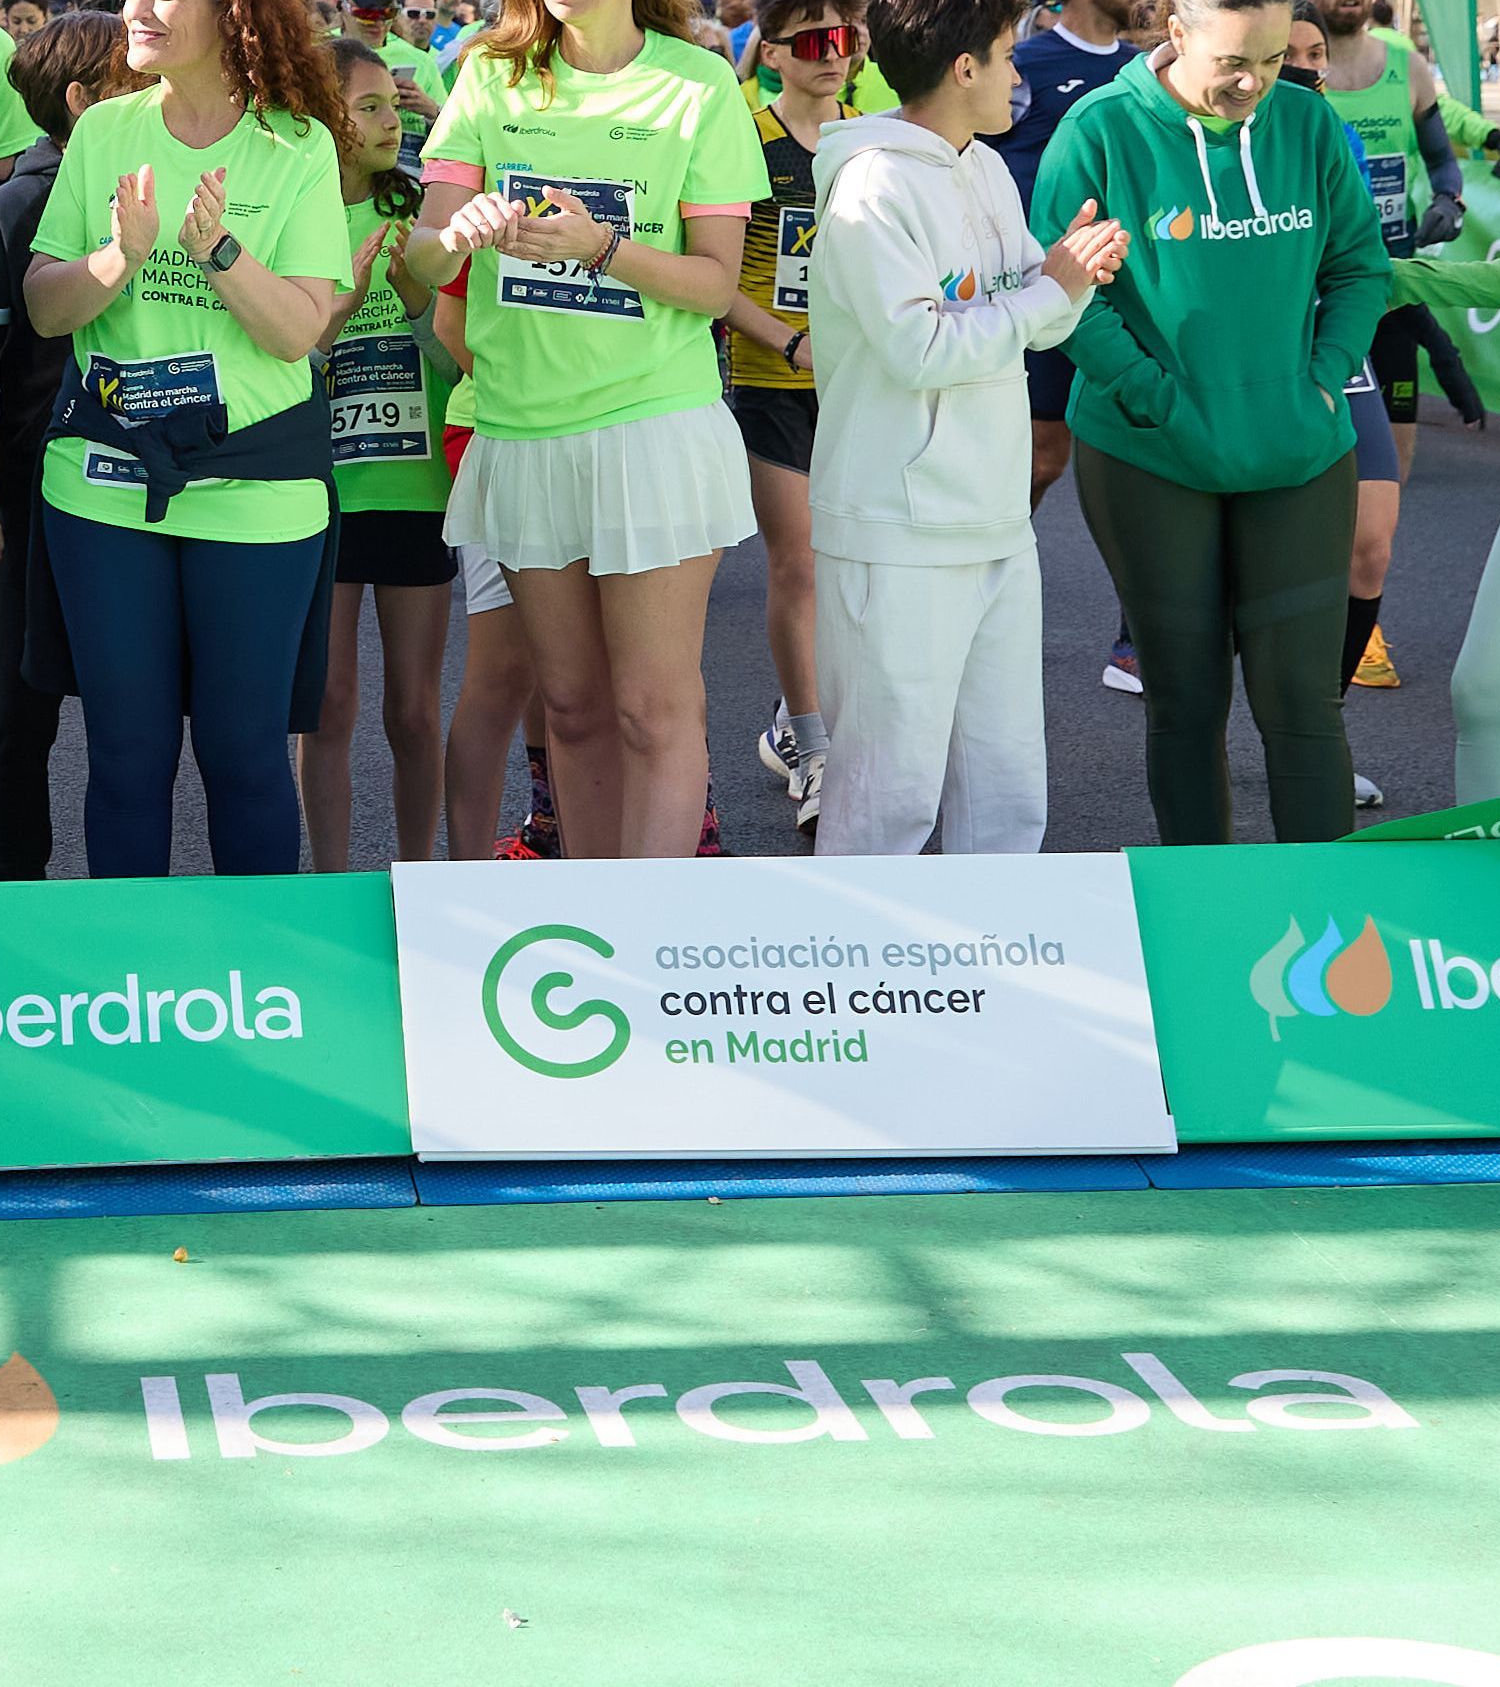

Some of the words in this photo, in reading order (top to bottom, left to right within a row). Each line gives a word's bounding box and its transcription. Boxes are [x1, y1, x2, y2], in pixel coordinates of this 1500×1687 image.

[495, 163, 533, 172] CARRERA
[1201, 202, 1314, 243] Iberdrola
[141, 290, 194, 307] CONTRA
[196, 296, 209, 308] EL
[343, 321, 382, 335] CONTRA
[382, 318, 394, 329] EL
[336, 365, 361, 376] Madrid
[373, 363, 403, 371] marcha
[337, 374, 367, 386] contra
[369, 371, 379, 381] el
[381, 369, 415, 381] cáncer
[123, 389, 152, 400] Madrid
[152, 389, 164, 397] en
[165, 385, 198, 395] marcha
[123, 399, 159, 410] contra
[160, 397, 172, 407] el
[173, 392, 212, 405] cáncer
[655, 933, 875, 973] asociación
[883, 929, 1065, 977] española
[659, 980, 795, 1018] contra
[803, 980, 838, 1016] el
[845, 975, 987, 1016] cáncer
[664, 1037, 717, 1065] en
[726, 1027, 870, 1065] Madrid
[138, 1352, 1421, 1463] Iberdrola
